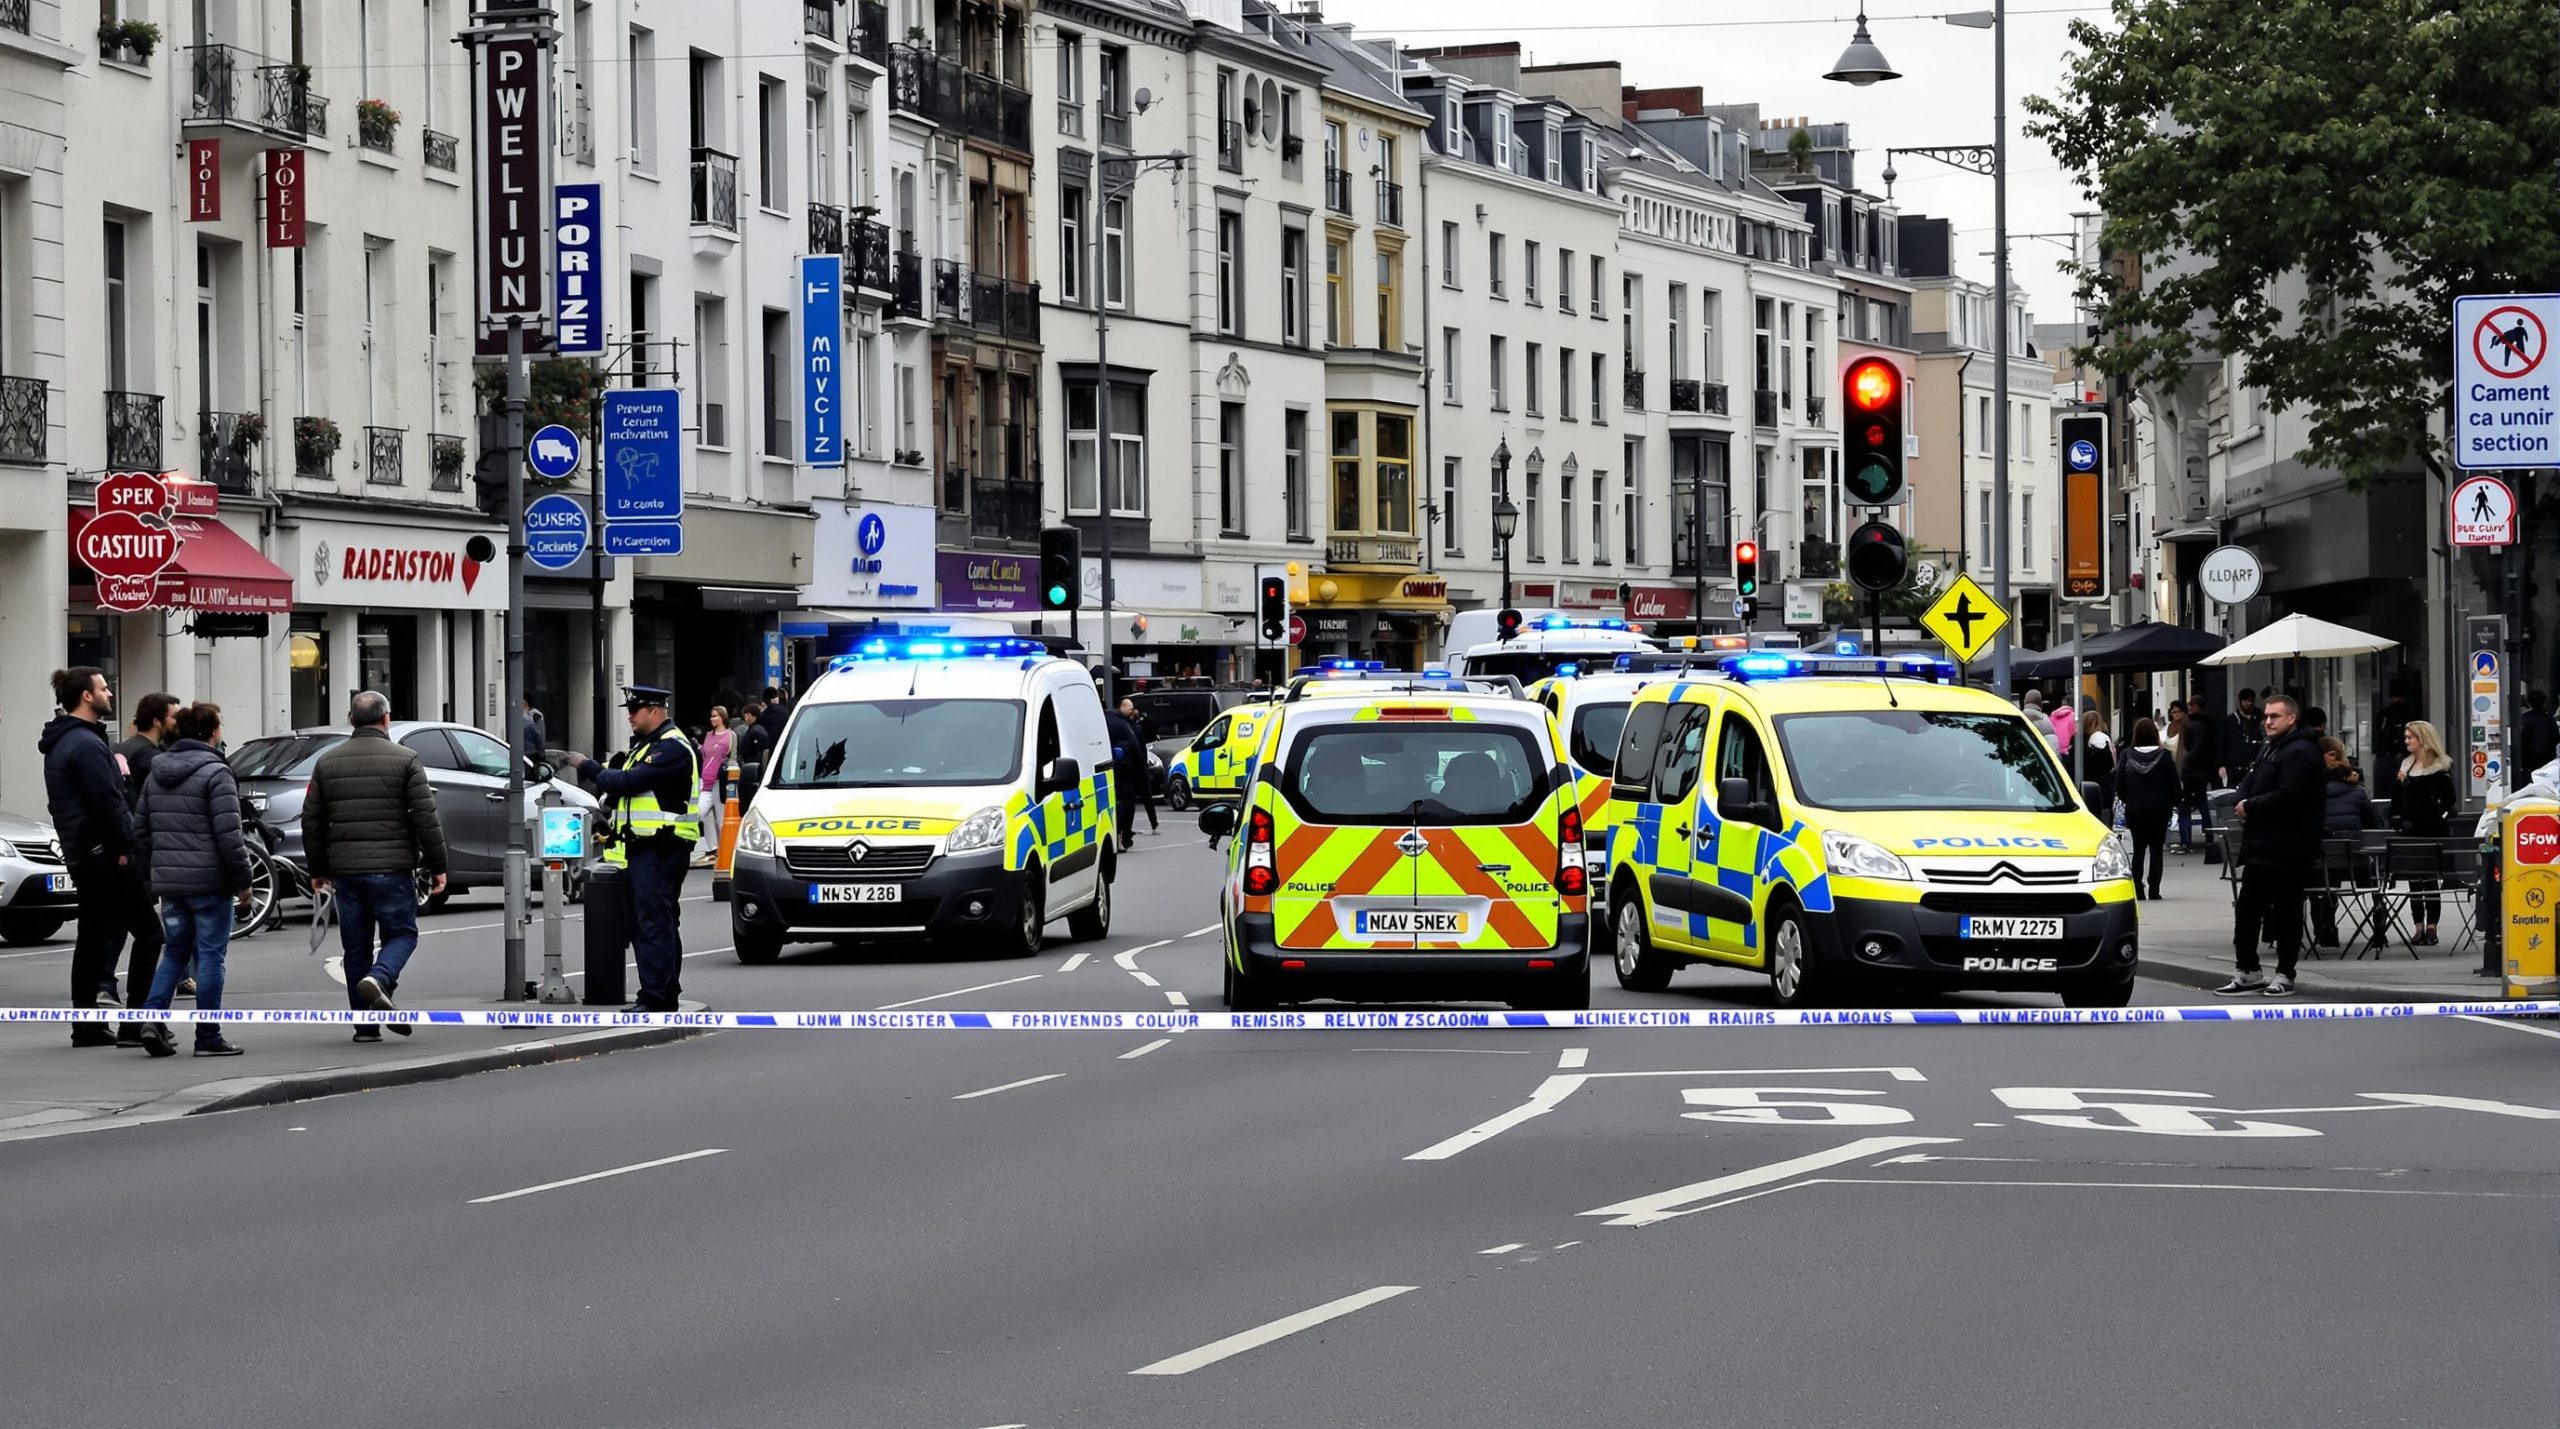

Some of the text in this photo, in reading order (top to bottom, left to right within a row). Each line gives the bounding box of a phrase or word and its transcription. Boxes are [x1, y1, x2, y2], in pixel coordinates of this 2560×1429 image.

[496, 50, 527, 307] PWELIUN
[557, 197, 590, 345] PORIZE
[2471, 384, 2550, 401] Cament
[2469, 413, 2493, 426] ca
[2472, 433, 2549, 451] section
[87, 534, 167, 559] CASTUIT
[343, 546, 456, 583] RADENSTON
[797, 820, 922, 833] POLICE
[1912, 837, 2069, 849] POLICE
[1506, 883, 1550, 893] POLICE
[2019, 919, 2057, 936] 2275
[1963, 957, 2058, 972] POLICE
[486, 1012, 520, 1024] NOW
